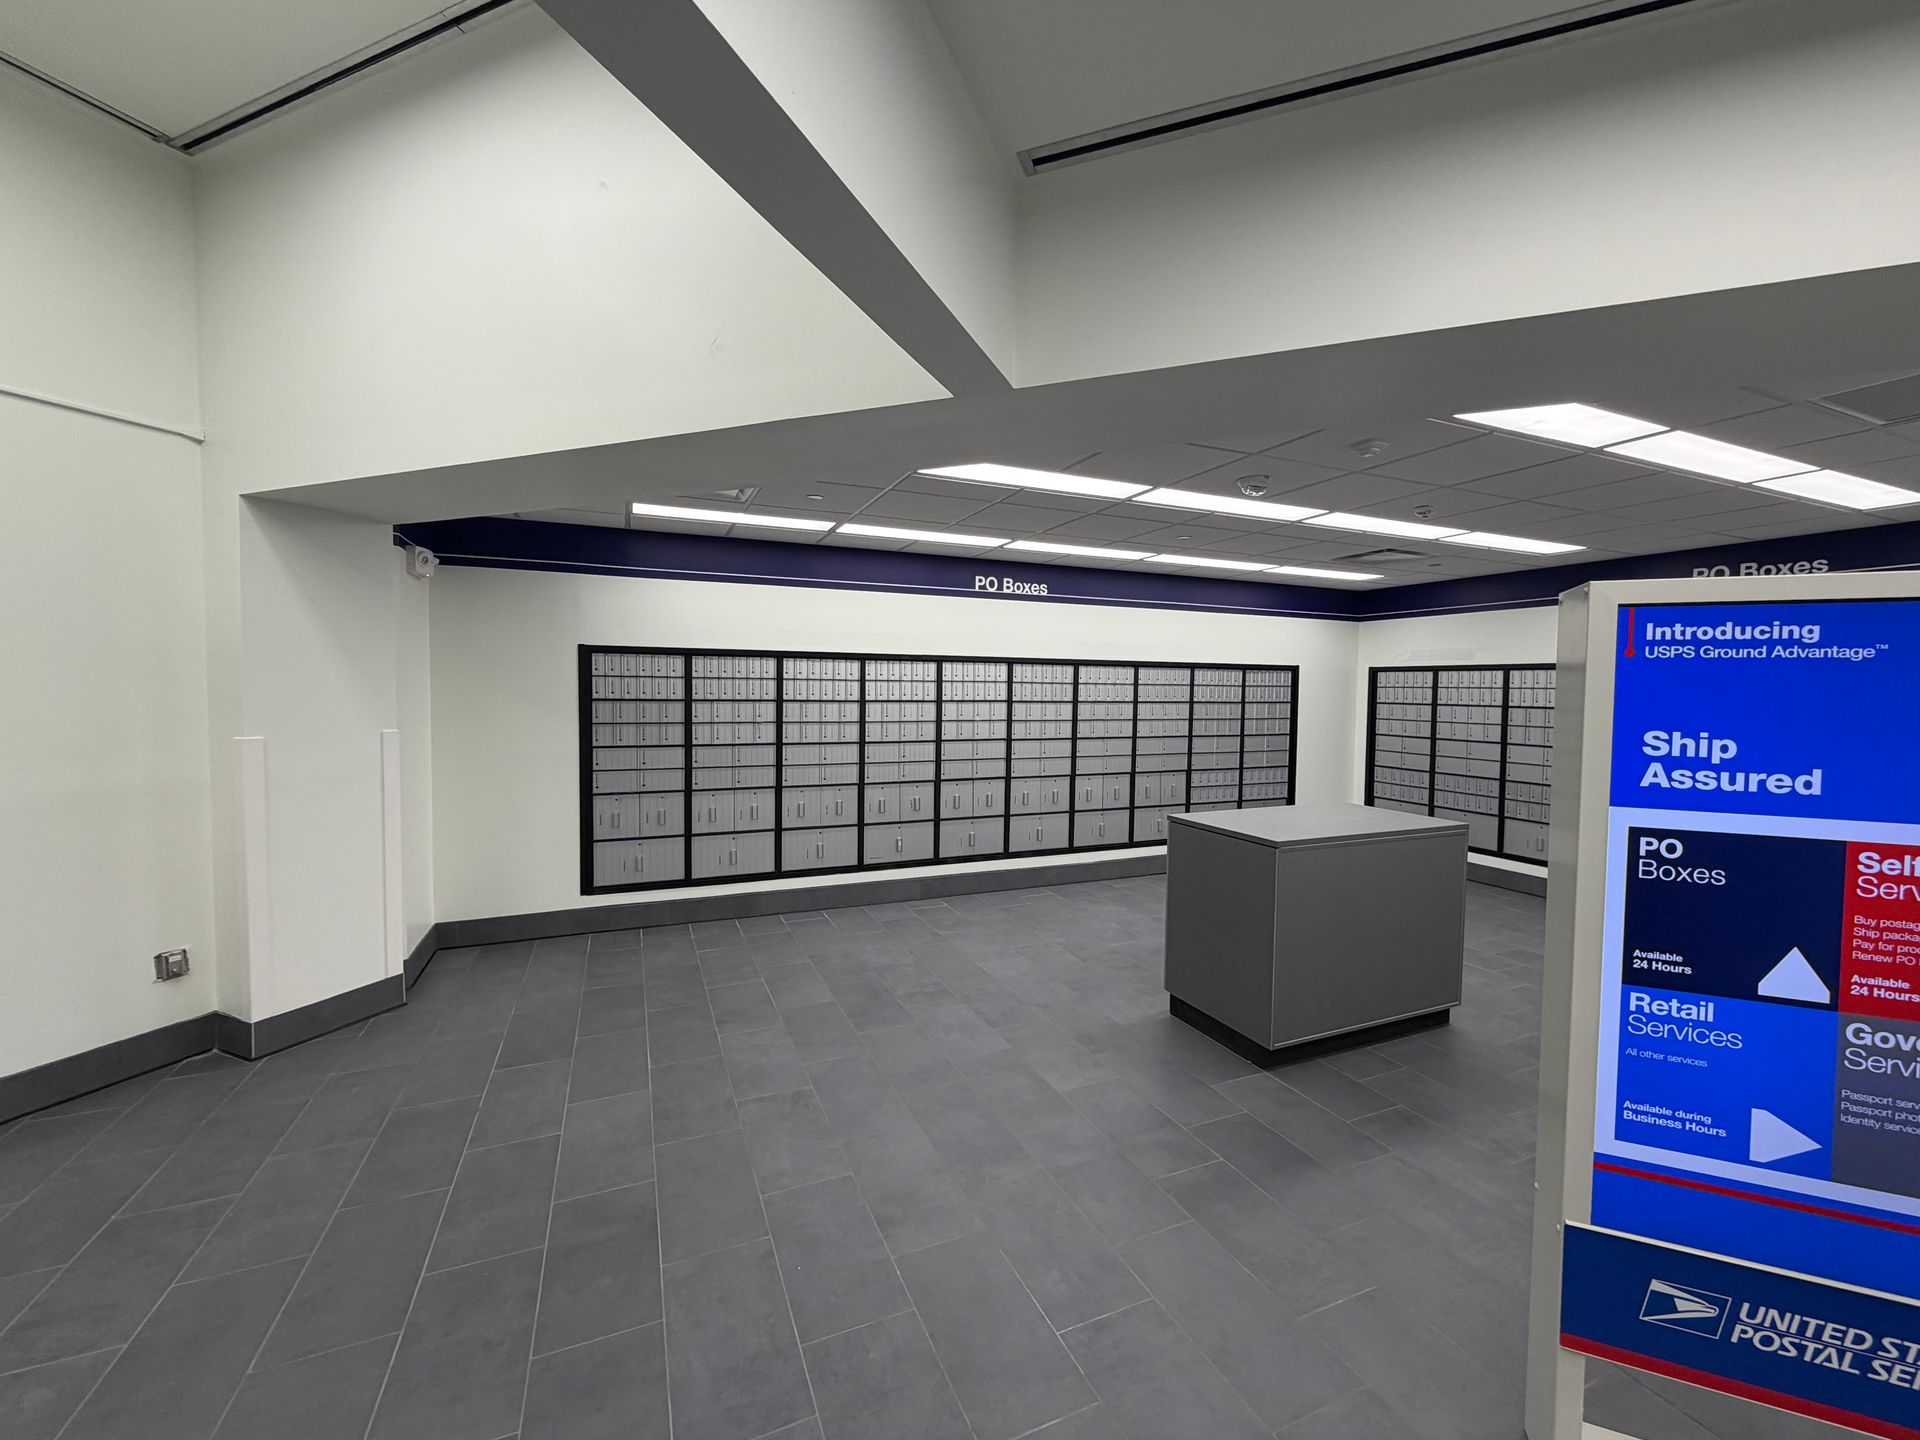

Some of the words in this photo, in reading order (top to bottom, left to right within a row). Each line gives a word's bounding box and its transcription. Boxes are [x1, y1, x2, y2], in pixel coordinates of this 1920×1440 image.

[1739, 559, 1829, 577] Boxes
[975, 575, 998, 592] PO
[1003, 577, 1048, 595] Boxes
[1646, 621, 1821, 643] Introducing
[1645, 645, 1696, 659] USPS
[1700, 645, 1767, 659] Ground
[1642, 730, 1738, 764] Ship
[1639, 762, 1823, 796] Assured
[1639, 836, 1684, 859] PO
[1638, 859, 1726, 885] Boxes
[1853, 914, 1877, 927] Buy
[1852, 938, 1875, 951] Pay
[1878, 941, 1895, 952] for
[1853, 927, 1880, 939] Ship
[1883, 932, 1920, 943] packa
[1633, 949, 1683, 963] Available
[1852, 950, 1893, 963] Renew
[1896, 955, 1916, 966] PO
[1633, 959, 1648, 969] 24
[1652, 961, 1692, 975] Hours
[1850, 974, 1910, 989] Available
[1850, 984, 1869, 996] 24
[1873, 987, 1920, 1002] Hours
[1629, 991, 1714, 1022] Retail
[1627, 1013, 1743, 1049] Services
[1845, 1022, 1920, 1052] Gov
[1625, 1047, 1637, 1056] All
[1639, 1050, 1665, 1060] other
[1667, 1054, 1708, 1067] services
[1841, 1089, 1893, 1106] Passport
[1623, 1100, 1673, 1116] Available
[1675, 1110, 1711, 1124] during
[1841, 1101, 1893, 1118] Passport
[1623, 1110, 1682, 1129] Business
[1685, 1121, 1727, 1137] Hours
[1840, 1113, 1881, 1129] Identity
[1739, 1302, 1873, 1350] UNITED
[1877, 1337, 1920, 1363] ST
[1730, 1324, 1860, 1375] POSTAL
